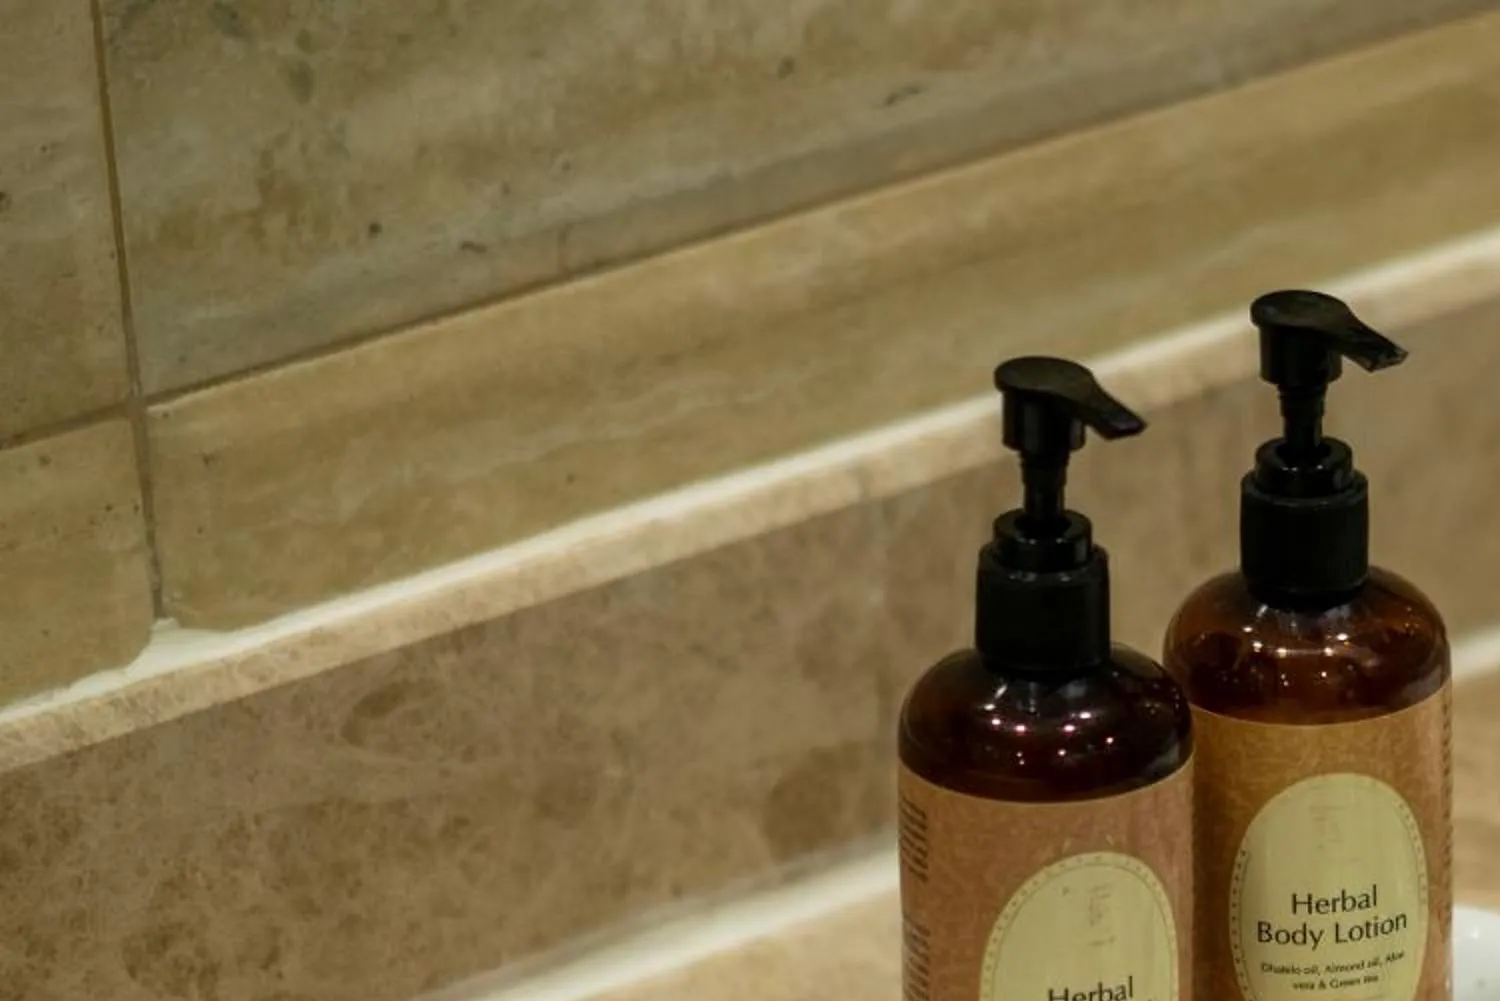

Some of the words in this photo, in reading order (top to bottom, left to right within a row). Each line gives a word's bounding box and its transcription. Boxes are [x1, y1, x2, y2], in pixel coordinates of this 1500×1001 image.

[1291, 883, 1377, 915] Herbal
[1257, 920, 1325, 951] Body
[1335, 913, 1407, 944] Lotion
[1325, 959, 1365, 974] Almond
